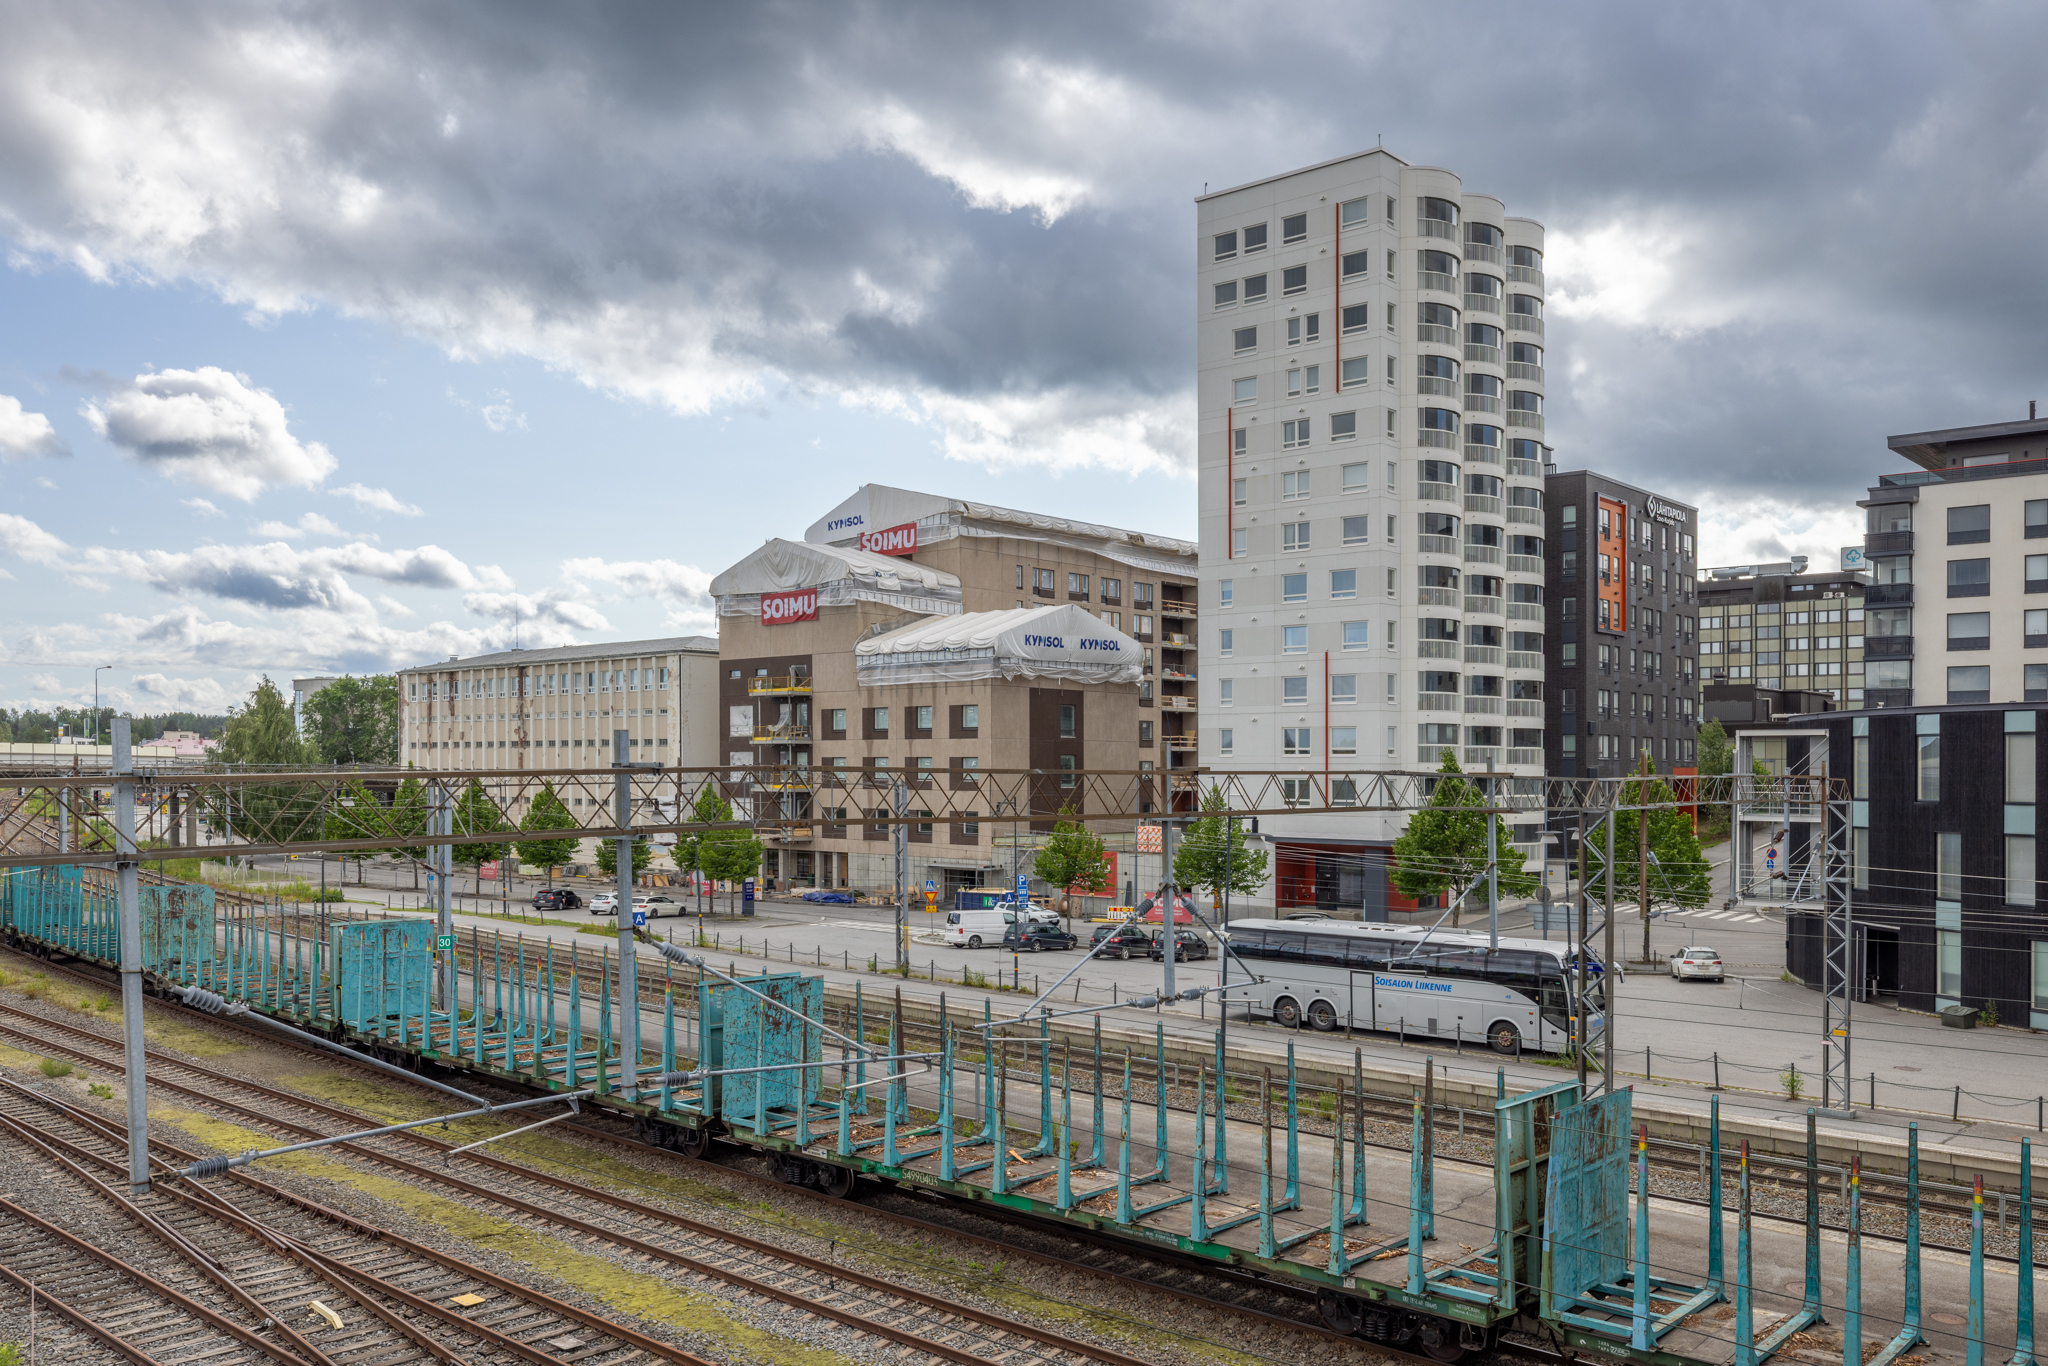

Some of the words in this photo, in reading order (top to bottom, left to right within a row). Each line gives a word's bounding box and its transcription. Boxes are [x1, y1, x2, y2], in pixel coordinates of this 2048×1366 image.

[827, 515, 864, 531] KYMSOL
[861, 528, 915, 552] SOIMU
[762, 594, 816, 620] SOIMU
[1024, 634, 1064, 648] KYMSOL
[1080, 638, 1121, 651] KYMSOL
[1018, 875, 1026, 885] P
[1006, 894, 1012, 902] A
[635, 914, 643, 923] A
[439, 938, 451, 947] 30
[902, 1168, 938, 1187] 54990403
